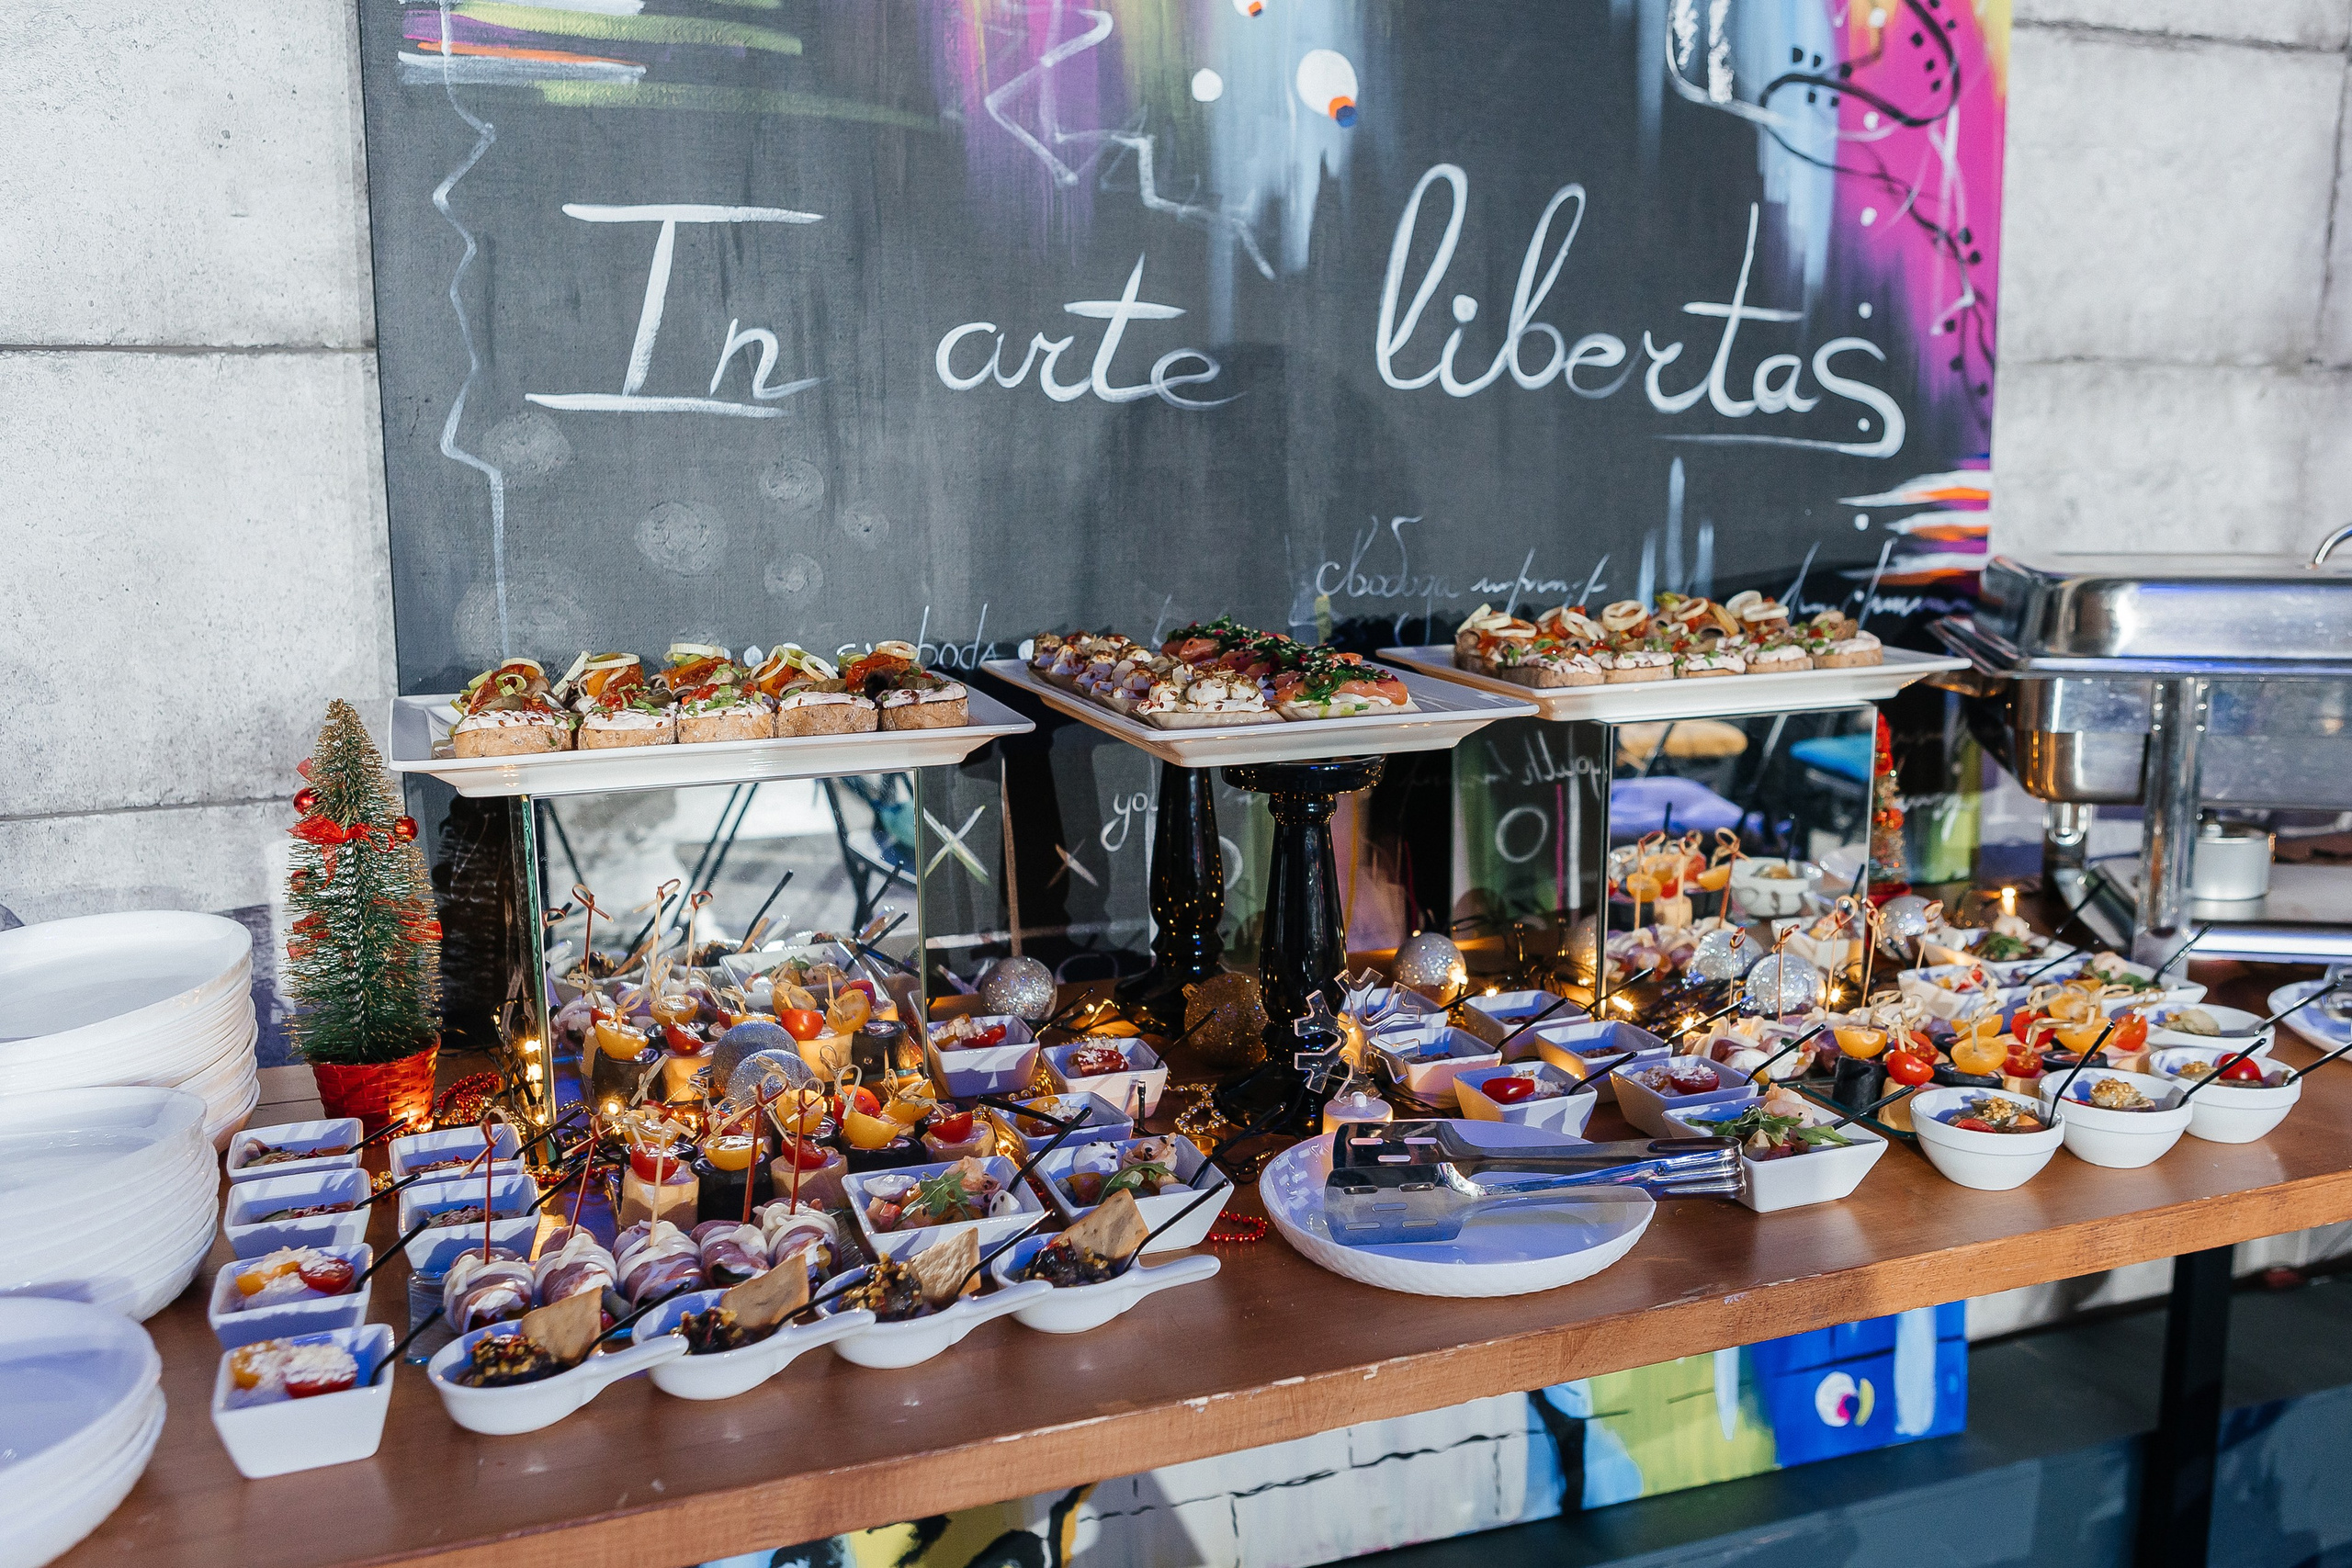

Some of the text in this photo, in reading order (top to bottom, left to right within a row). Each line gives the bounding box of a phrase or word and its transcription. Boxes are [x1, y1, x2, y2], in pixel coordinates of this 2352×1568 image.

[525, 163, 1906, 458] In arte libertas
